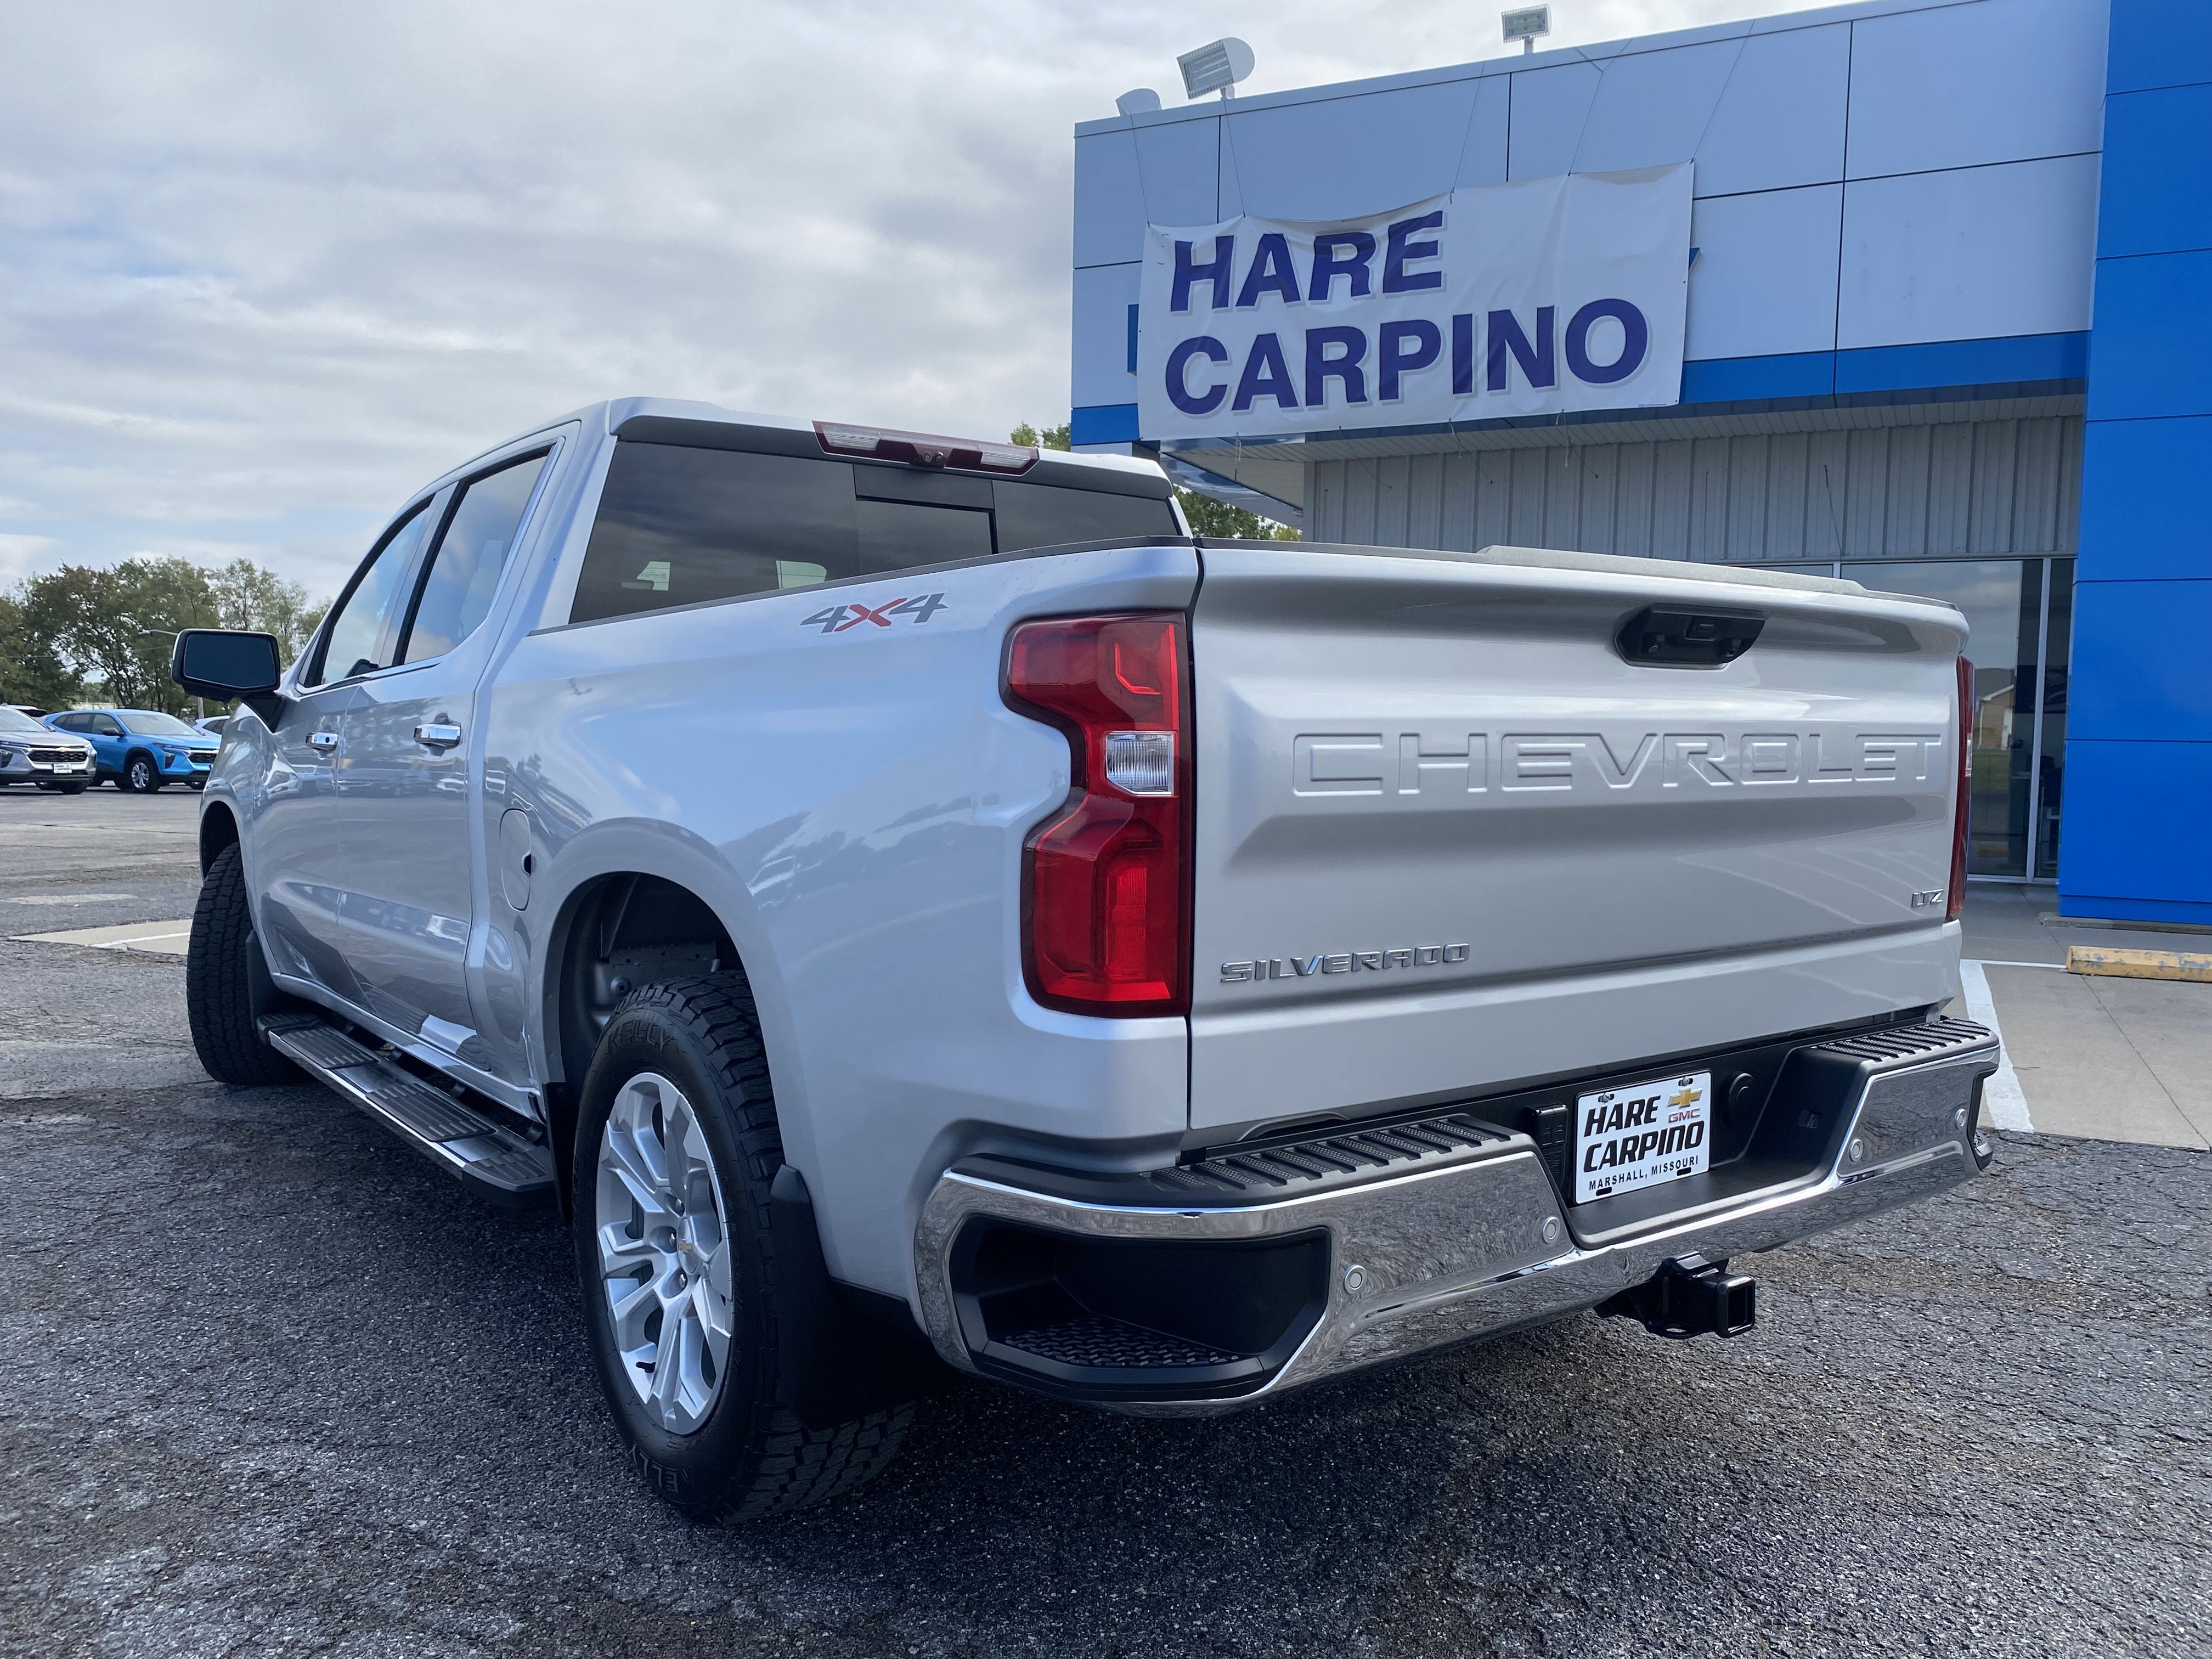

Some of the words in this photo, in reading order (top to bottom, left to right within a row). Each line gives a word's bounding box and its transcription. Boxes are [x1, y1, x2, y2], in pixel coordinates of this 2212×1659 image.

[1170, 211, 1444, 312] HARE
[1165, 298, 1647, 415] CARPINO
[1293, 731, 1942, 797] CHEVROLET
[1909, 889, 1944, 908] LTZ
[1220, 943, 1470, 984] SILVERADO
[608, 1019, 675, 1056] KELLY
[1584, 1095, 1661, 1137] HARE
[1668, 1108, 1701, 1124] GMC
[1583, 1120, 1705, 1173] CARPINO
[1589, 1173, 1647, 1191] MARSHALL,
[1651, 1155, 1699, 1176] MISSOURI
